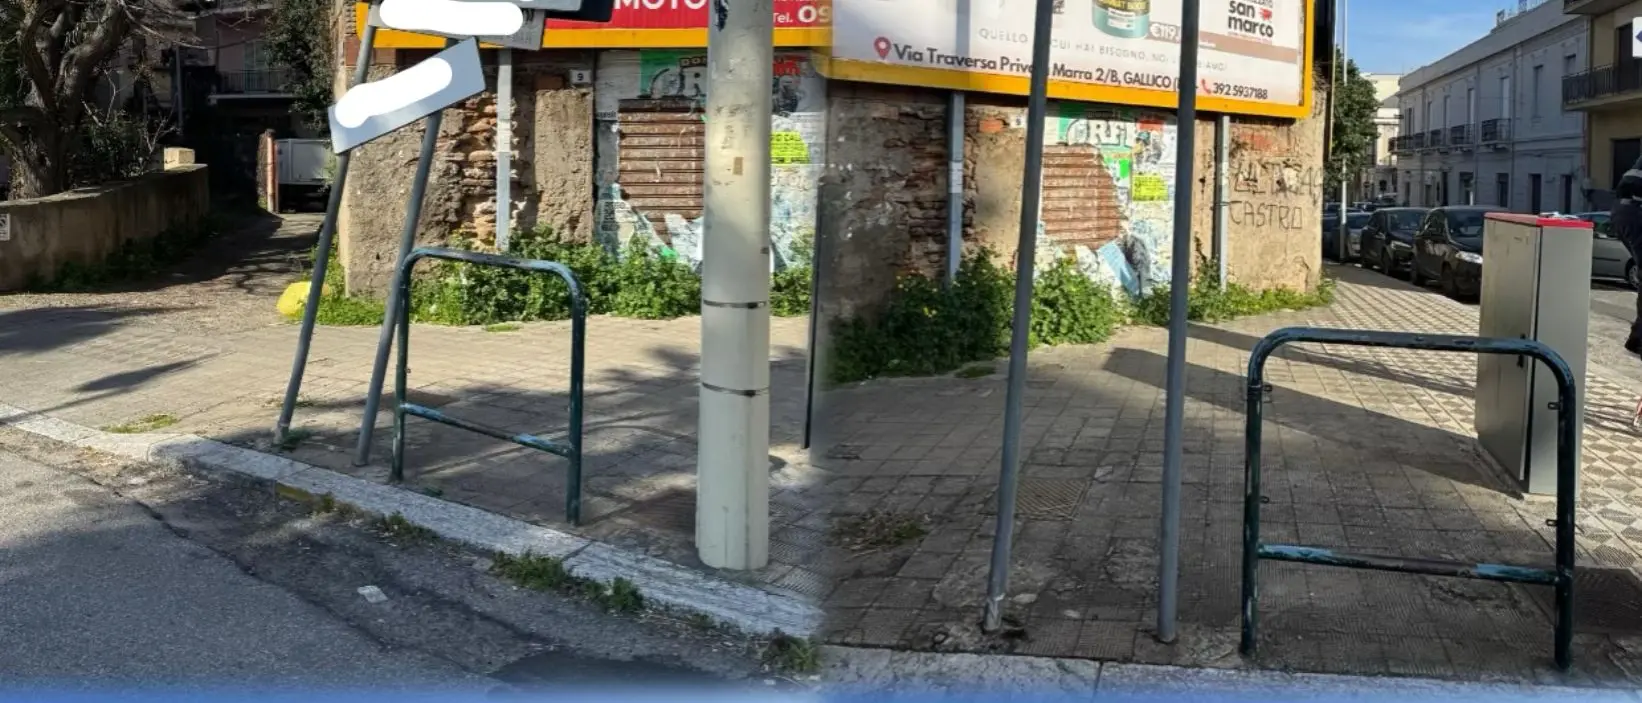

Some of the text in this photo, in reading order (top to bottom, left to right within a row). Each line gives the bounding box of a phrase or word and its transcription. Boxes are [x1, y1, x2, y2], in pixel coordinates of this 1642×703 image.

[1228, 0, 1256, 19] san
[978, 28, 1029, 43] QUELLO
[1227, 16, 1274, 38] marco
[893, 42, 924, 63] Via
[927, 47, 997, 70] Traversa
[1052, 62, 1092, 80] Marra
[1123, 71, 1172, 88] GALLICO
[1229, 200, 1303, 229] CASTRO
